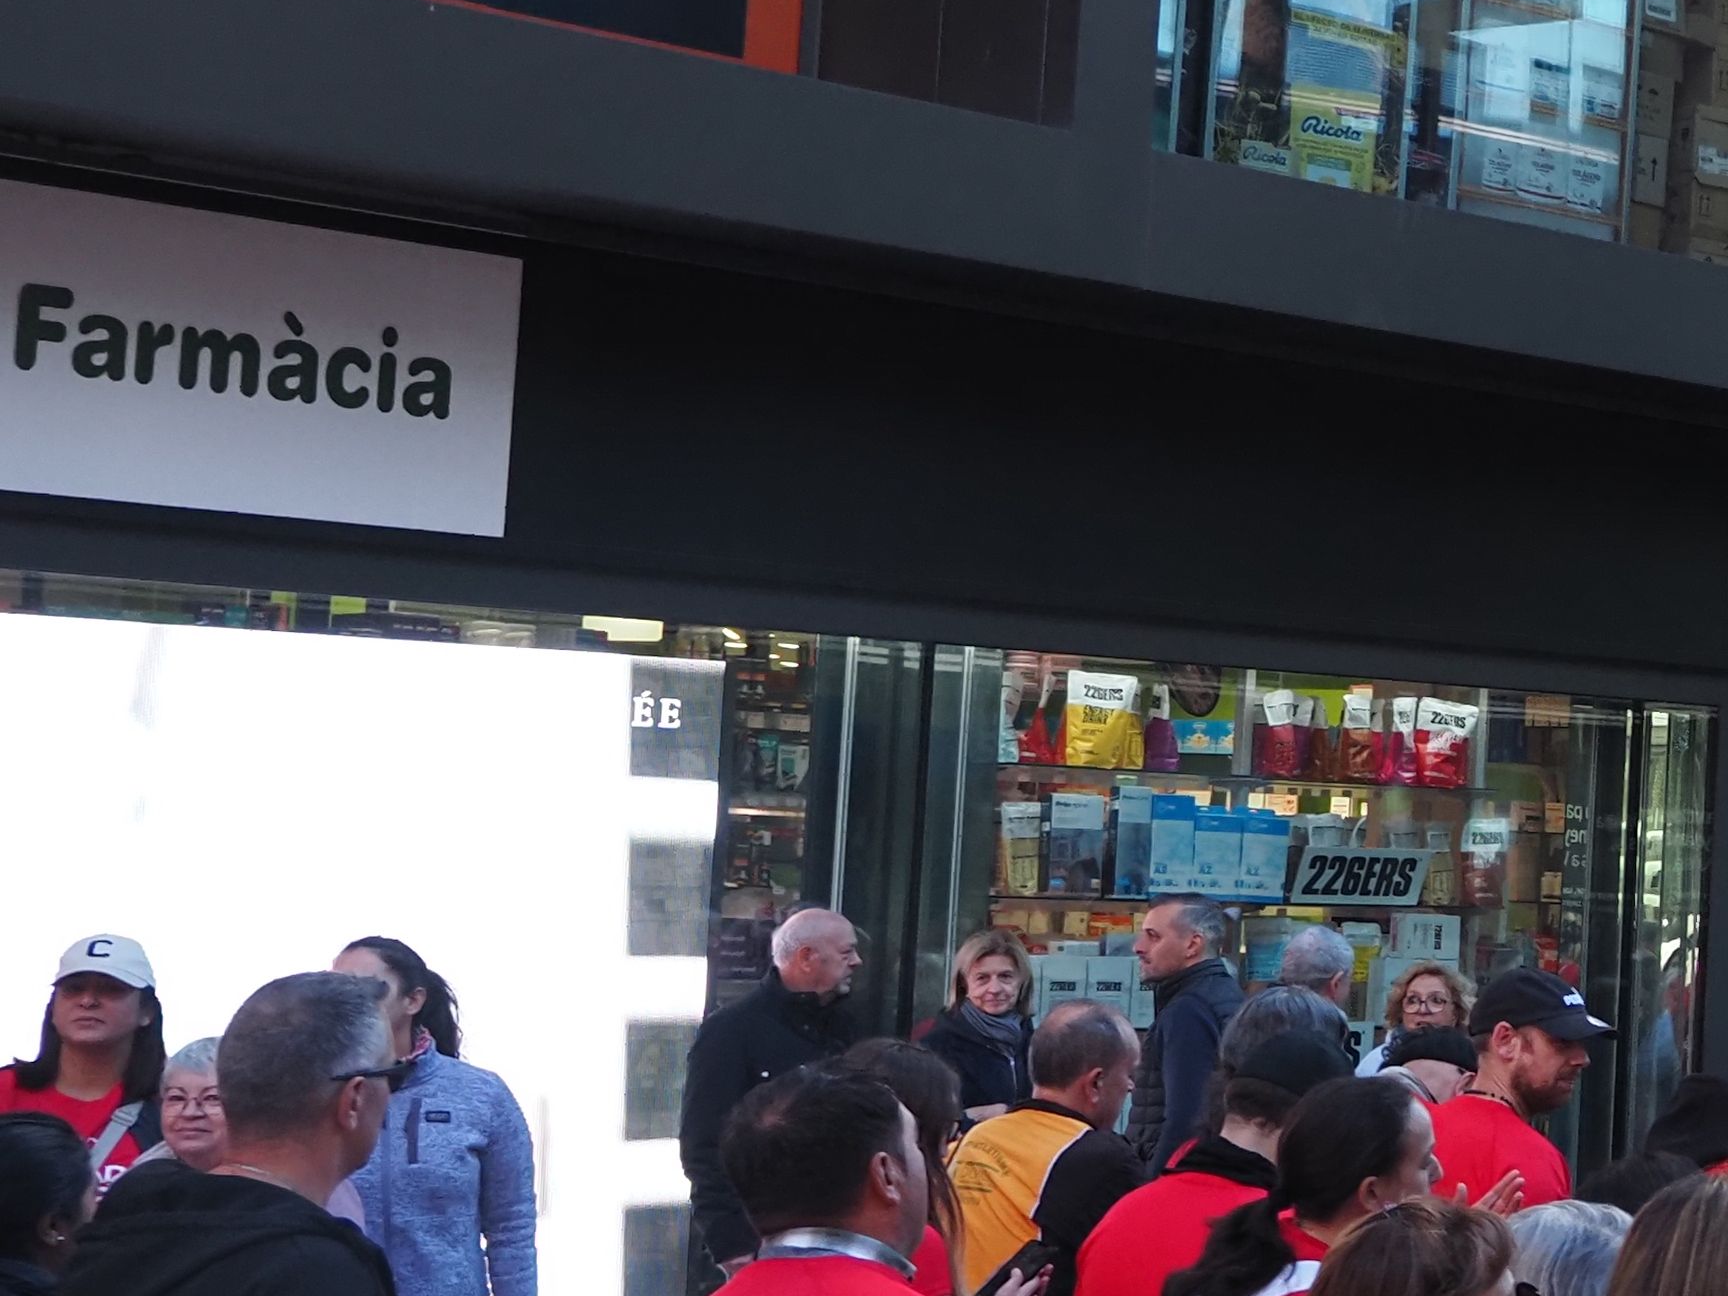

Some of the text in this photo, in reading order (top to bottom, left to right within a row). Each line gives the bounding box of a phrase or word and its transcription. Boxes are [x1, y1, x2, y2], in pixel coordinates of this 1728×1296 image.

[1301, 115, 1362, 142] Ricola
[1242, 144, 1288, 167] Ricola
[14, 281, 453, 420] Farmàcia
[1301, 854, 1419, 897] 226ERS
[86, 939, 113, 959] C
